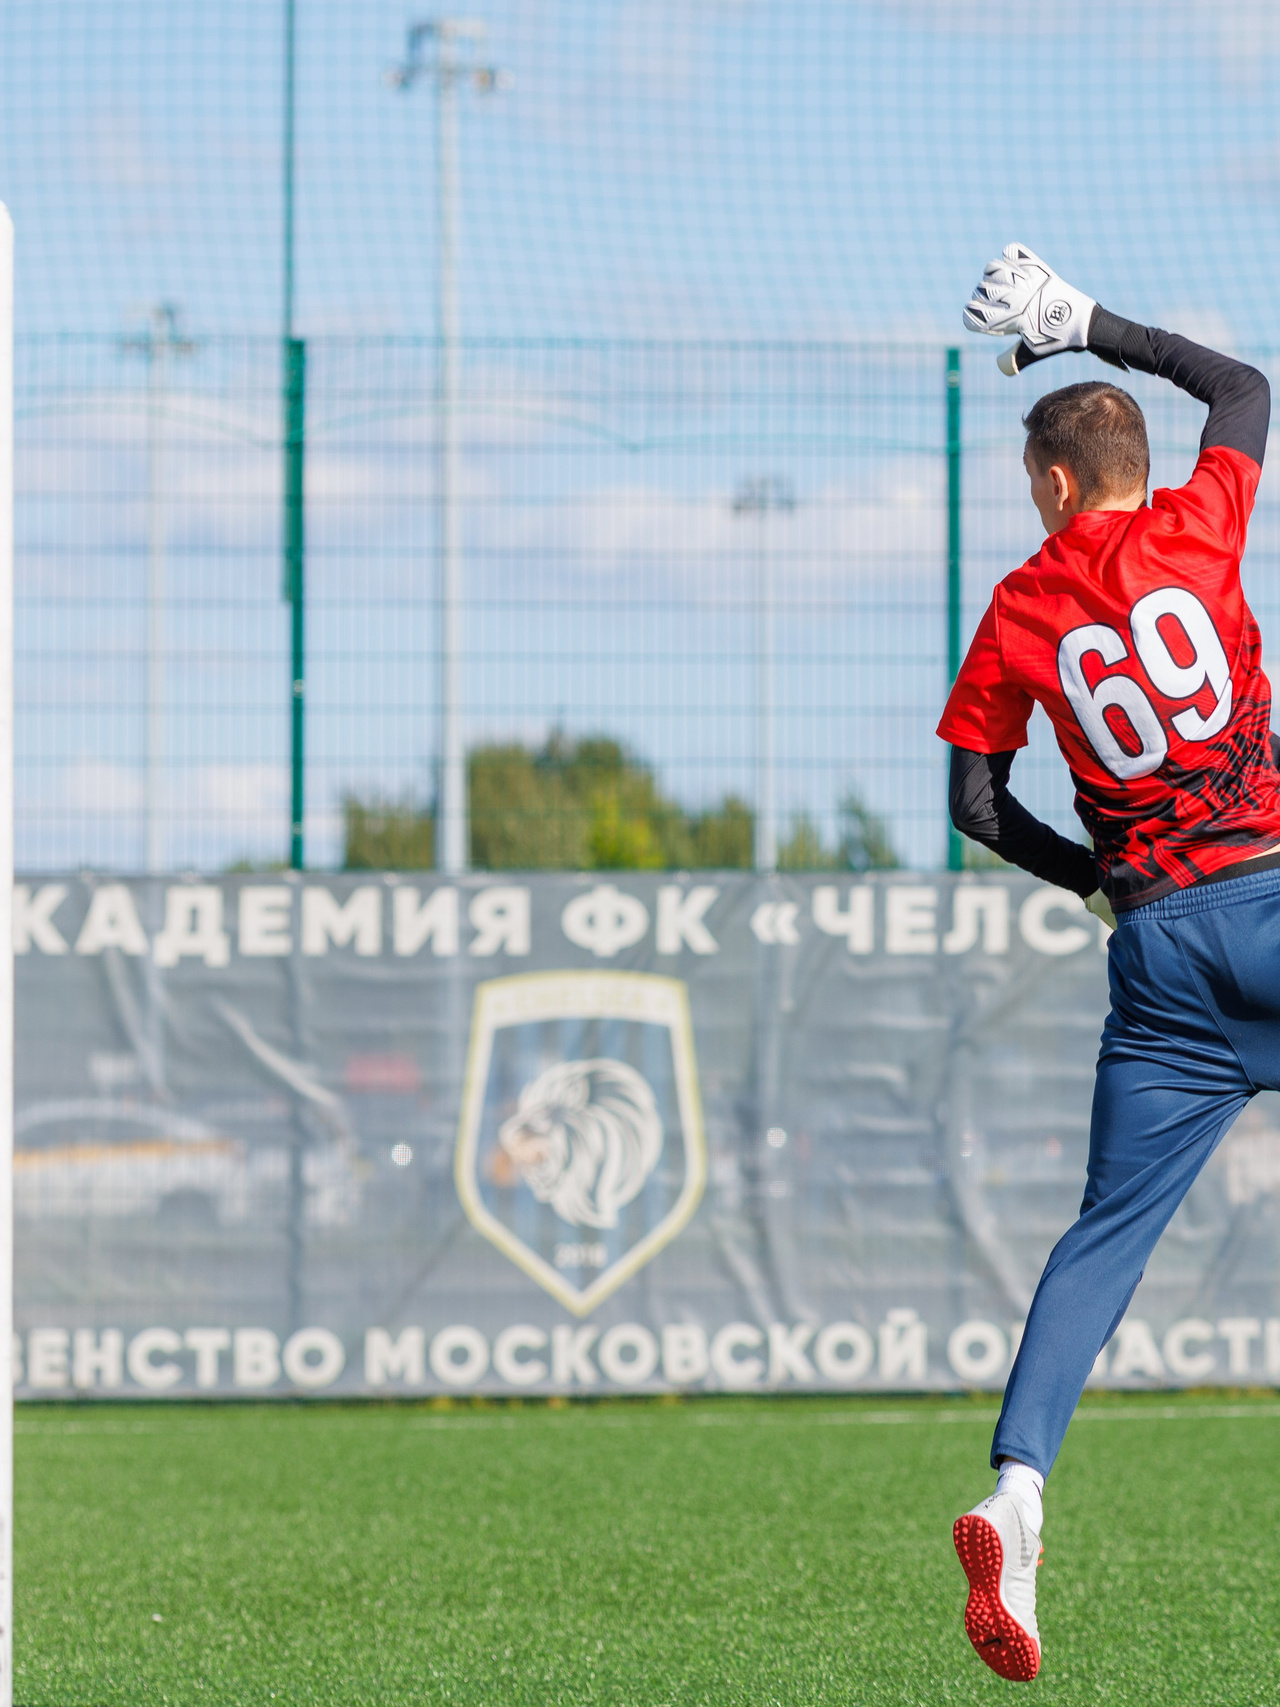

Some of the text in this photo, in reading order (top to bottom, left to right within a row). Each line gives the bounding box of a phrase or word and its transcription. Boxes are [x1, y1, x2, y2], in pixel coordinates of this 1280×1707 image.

[1056, 586, 1233, 780] 69
[560, 884, 719, 957] ФК
[750, 884, 1115, 956] «ЧЕЛС
[12, 1325, 346, 1389] ЕНСТВО
[364, 1308, 928, 1390] МОСКОВСКОЙ
